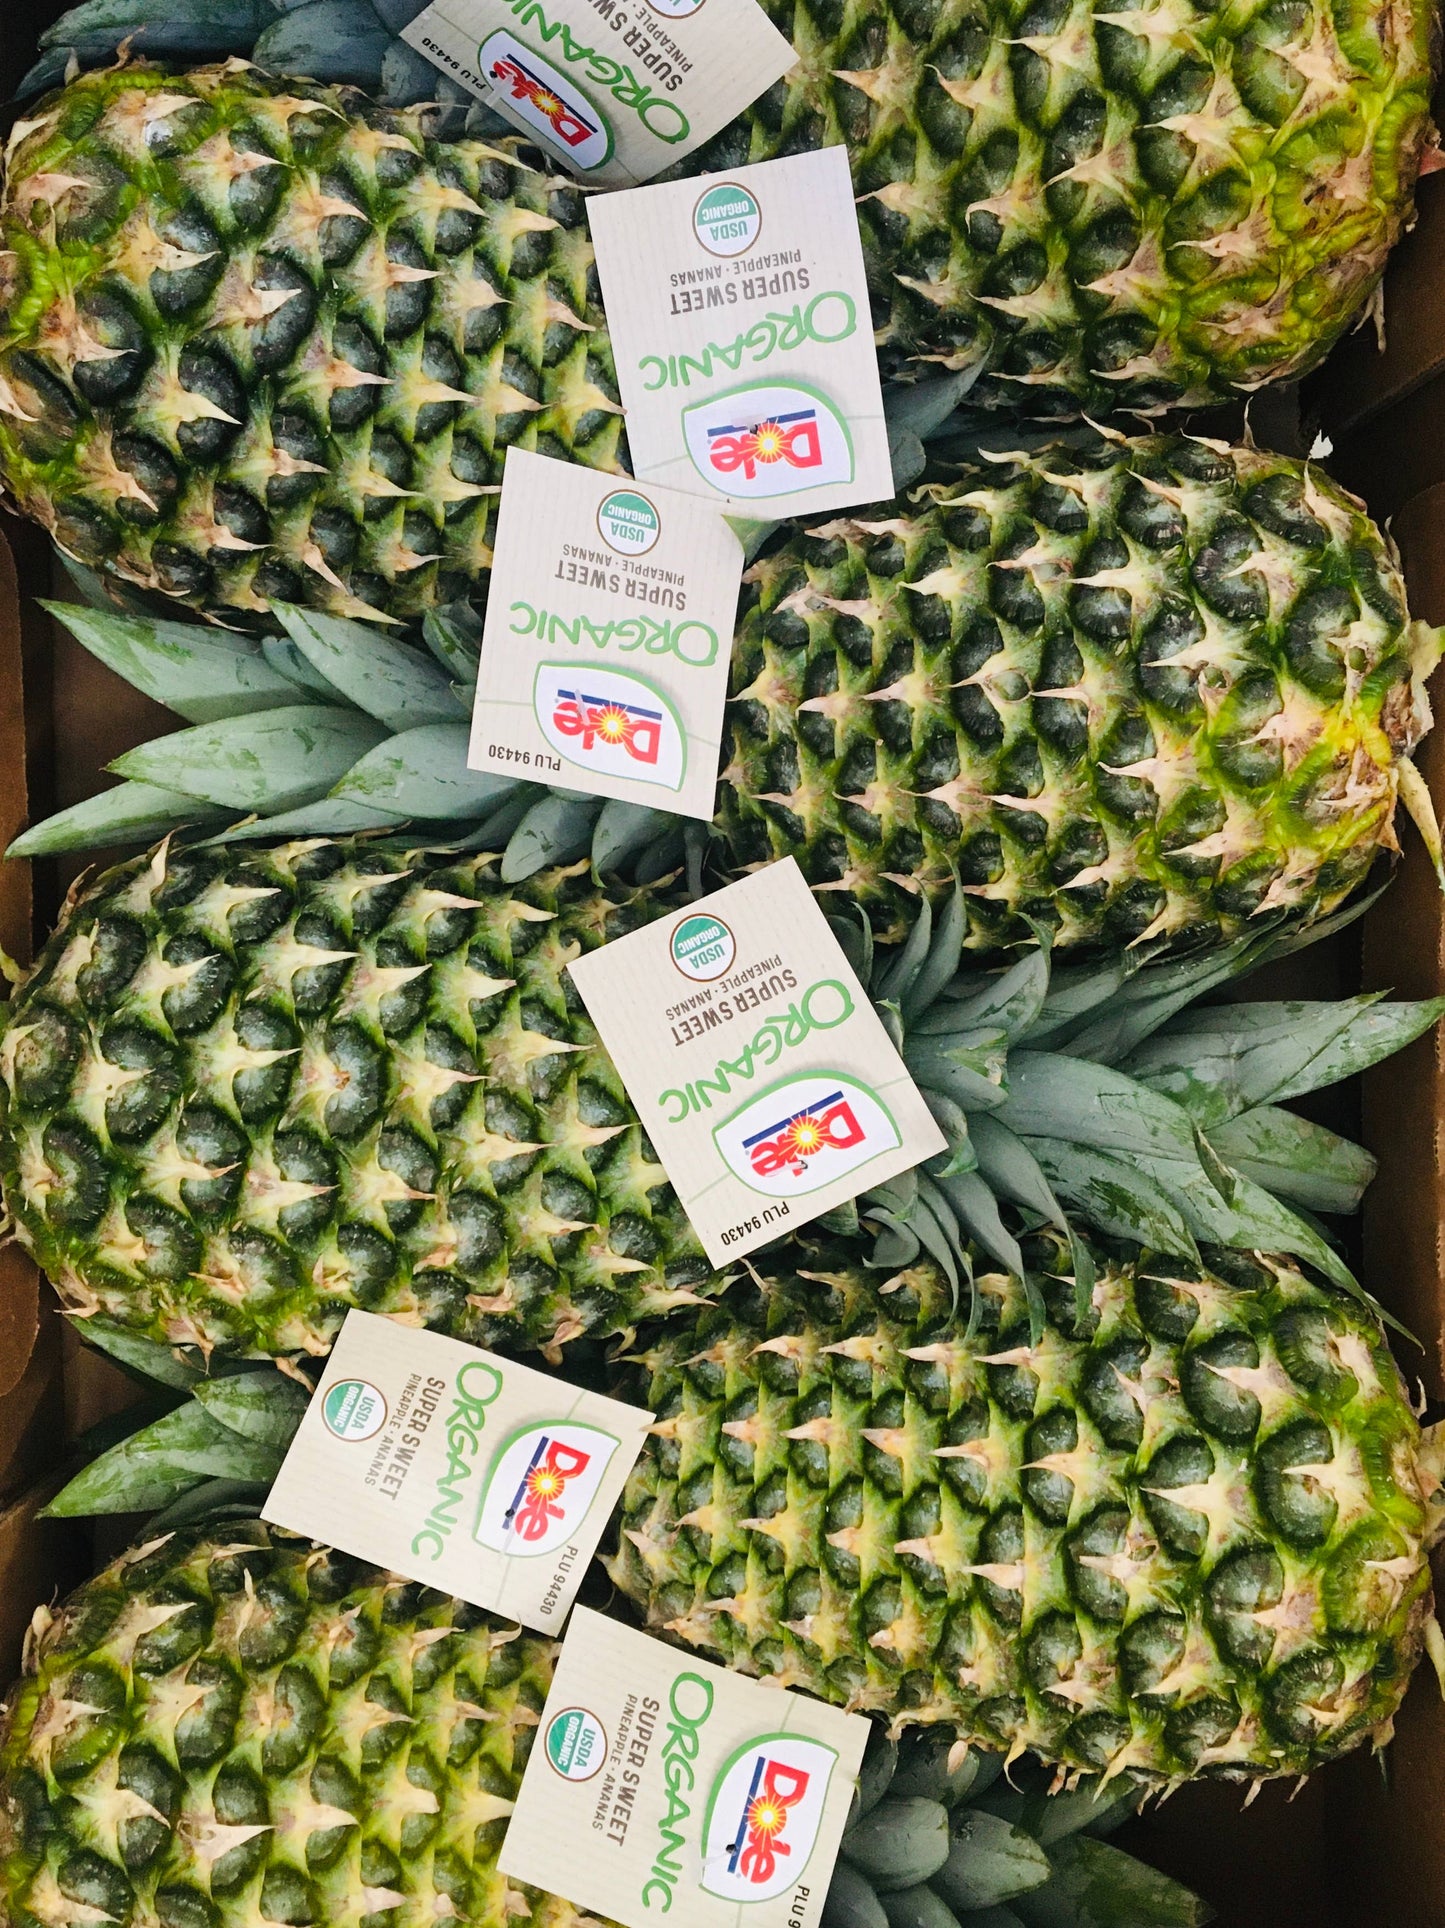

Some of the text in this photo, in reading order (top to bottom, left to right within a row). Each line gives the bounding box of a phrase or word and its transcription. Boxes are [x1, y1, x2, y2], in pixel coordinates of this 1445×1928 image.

[421, 37, 487, 91] PLU 94430
[503, 0, 690, 144] ORGANI
[623, 26, 684, 91] SUPER
[635, 7, 694, 73] PINEAPPLE
[493, 60, 593, 147] Dole
[702, 200, 749, 221] ORGANIC
[710, 220, 748, 242] USDA
[670, 249, 801, 287] PINEAPPLE ANANAS
[670, 268, 810, 315] SUPER SWEET
[639, 291, 857, 390] ORGANIC
[710, 421, 823, 480] Dole
[608, 503, 652, 525] ORGANIC
[611, 521, 645, 544] USDA
[555, 559, 687, 611] SUPER SWEET
[563, 543, 685, 586] PINEAPPLE ANANAS
[509, 601, 719, 666] ORGANIC
[488, 744, 561, 772] PLU 94430
[553, 701, 662, 765] Dole
[677, 925, 721, 955] ORGANIC
[689, 944, 726, 969] USDA
[666, 954, 783, 1021] PINEAPPLE ANANAS
[673, 969, 798, 1047] SUPER SWEET
[658, 979, 855, 1123] ORGANIC
[750, 1101, 866, 1178] Dole
[720, 1201, 790, 1246] PLU 94430
[333, 1384, 359, 1428] ORGANIC
[351, 1396, 376, 1429] USDA
[364, 1373, 422, 1487] PINEAPPLE ANANAS
[379, 1376, 445, 1501] SUPER SWEET
[411, 1361, 503, 1561] ORGANIC
[514, 1440, 591, 1541] Dole
[539, 1545, 578, 1616] PLU 94430
[556, 1717, 579, 1767] ORGANIC
[575, 1727, 596, 1768] USDA
[592, 1693, 638, 1831] PINEAPPLE ANANAS
[607, 1696, 660, 1847] SUPER SWEET
[642, 1671, 714, 1913] ORGANIC
[740, 1760, 810, 1883] Dole
[792, 1885, 810, 1917] PLU
